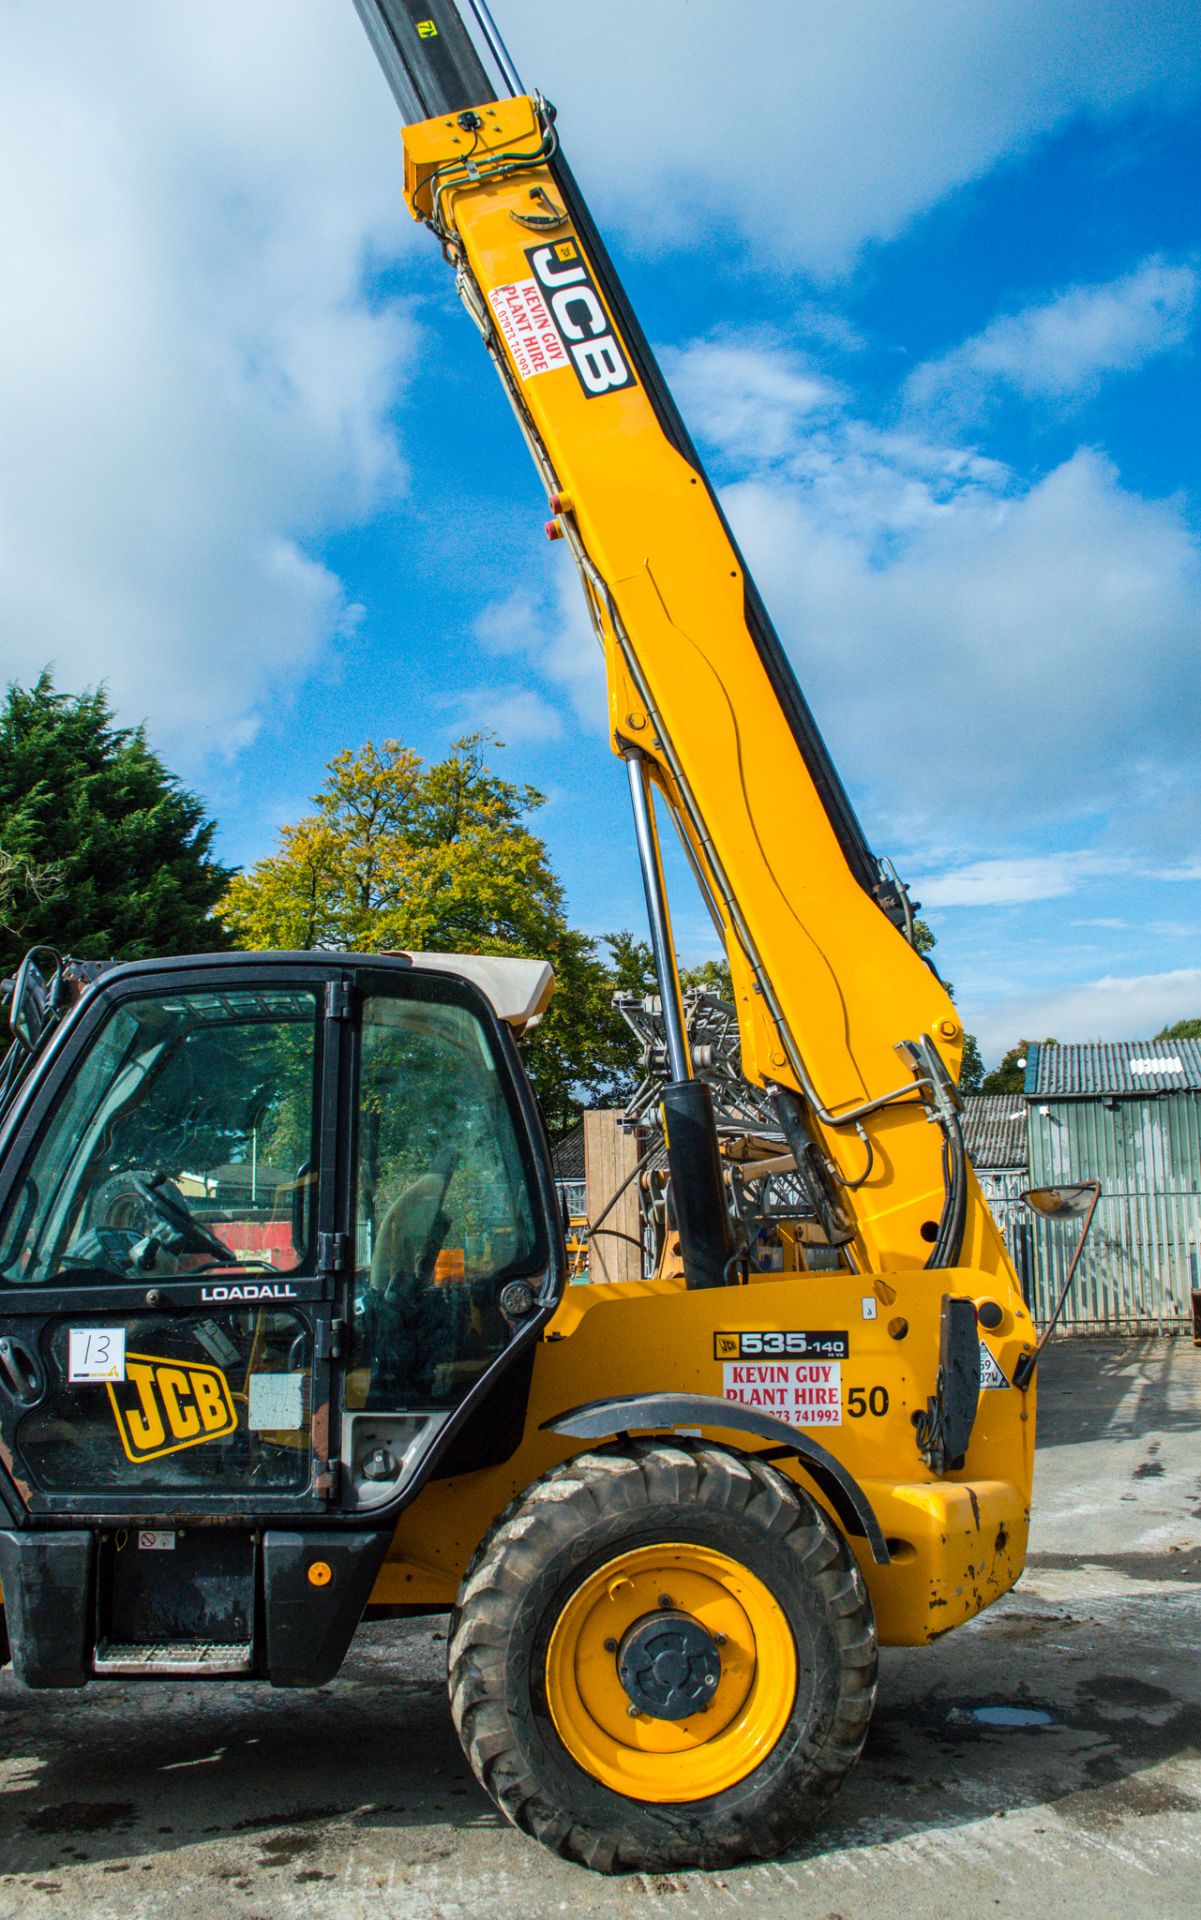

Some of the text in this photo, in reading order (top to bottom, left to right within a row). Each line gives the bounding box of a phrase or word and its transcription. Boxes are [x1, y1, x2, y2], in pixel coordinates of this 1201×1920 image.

[502, 286, 549, 372] PLANT HIRE
[522, 286, 564, 360] KEVIN GUY
[533, 248, 628, 393] JCB
[497, 310, 516, 342] 07973
[510, 341, 531, 377] 741992
[201, 1284, 297, 1301] LOADALL
[84, 1335, 110, 1364] 13
[732, 1366, 832, 1384] KEVIN GUY
[125, 1362, 229, 1450] JCB
[726, 1388, 839, 1406] PLANT HIRE
[847, 1386, 889, 1418] 50
[795, 1409, 839, 1422] 741992
